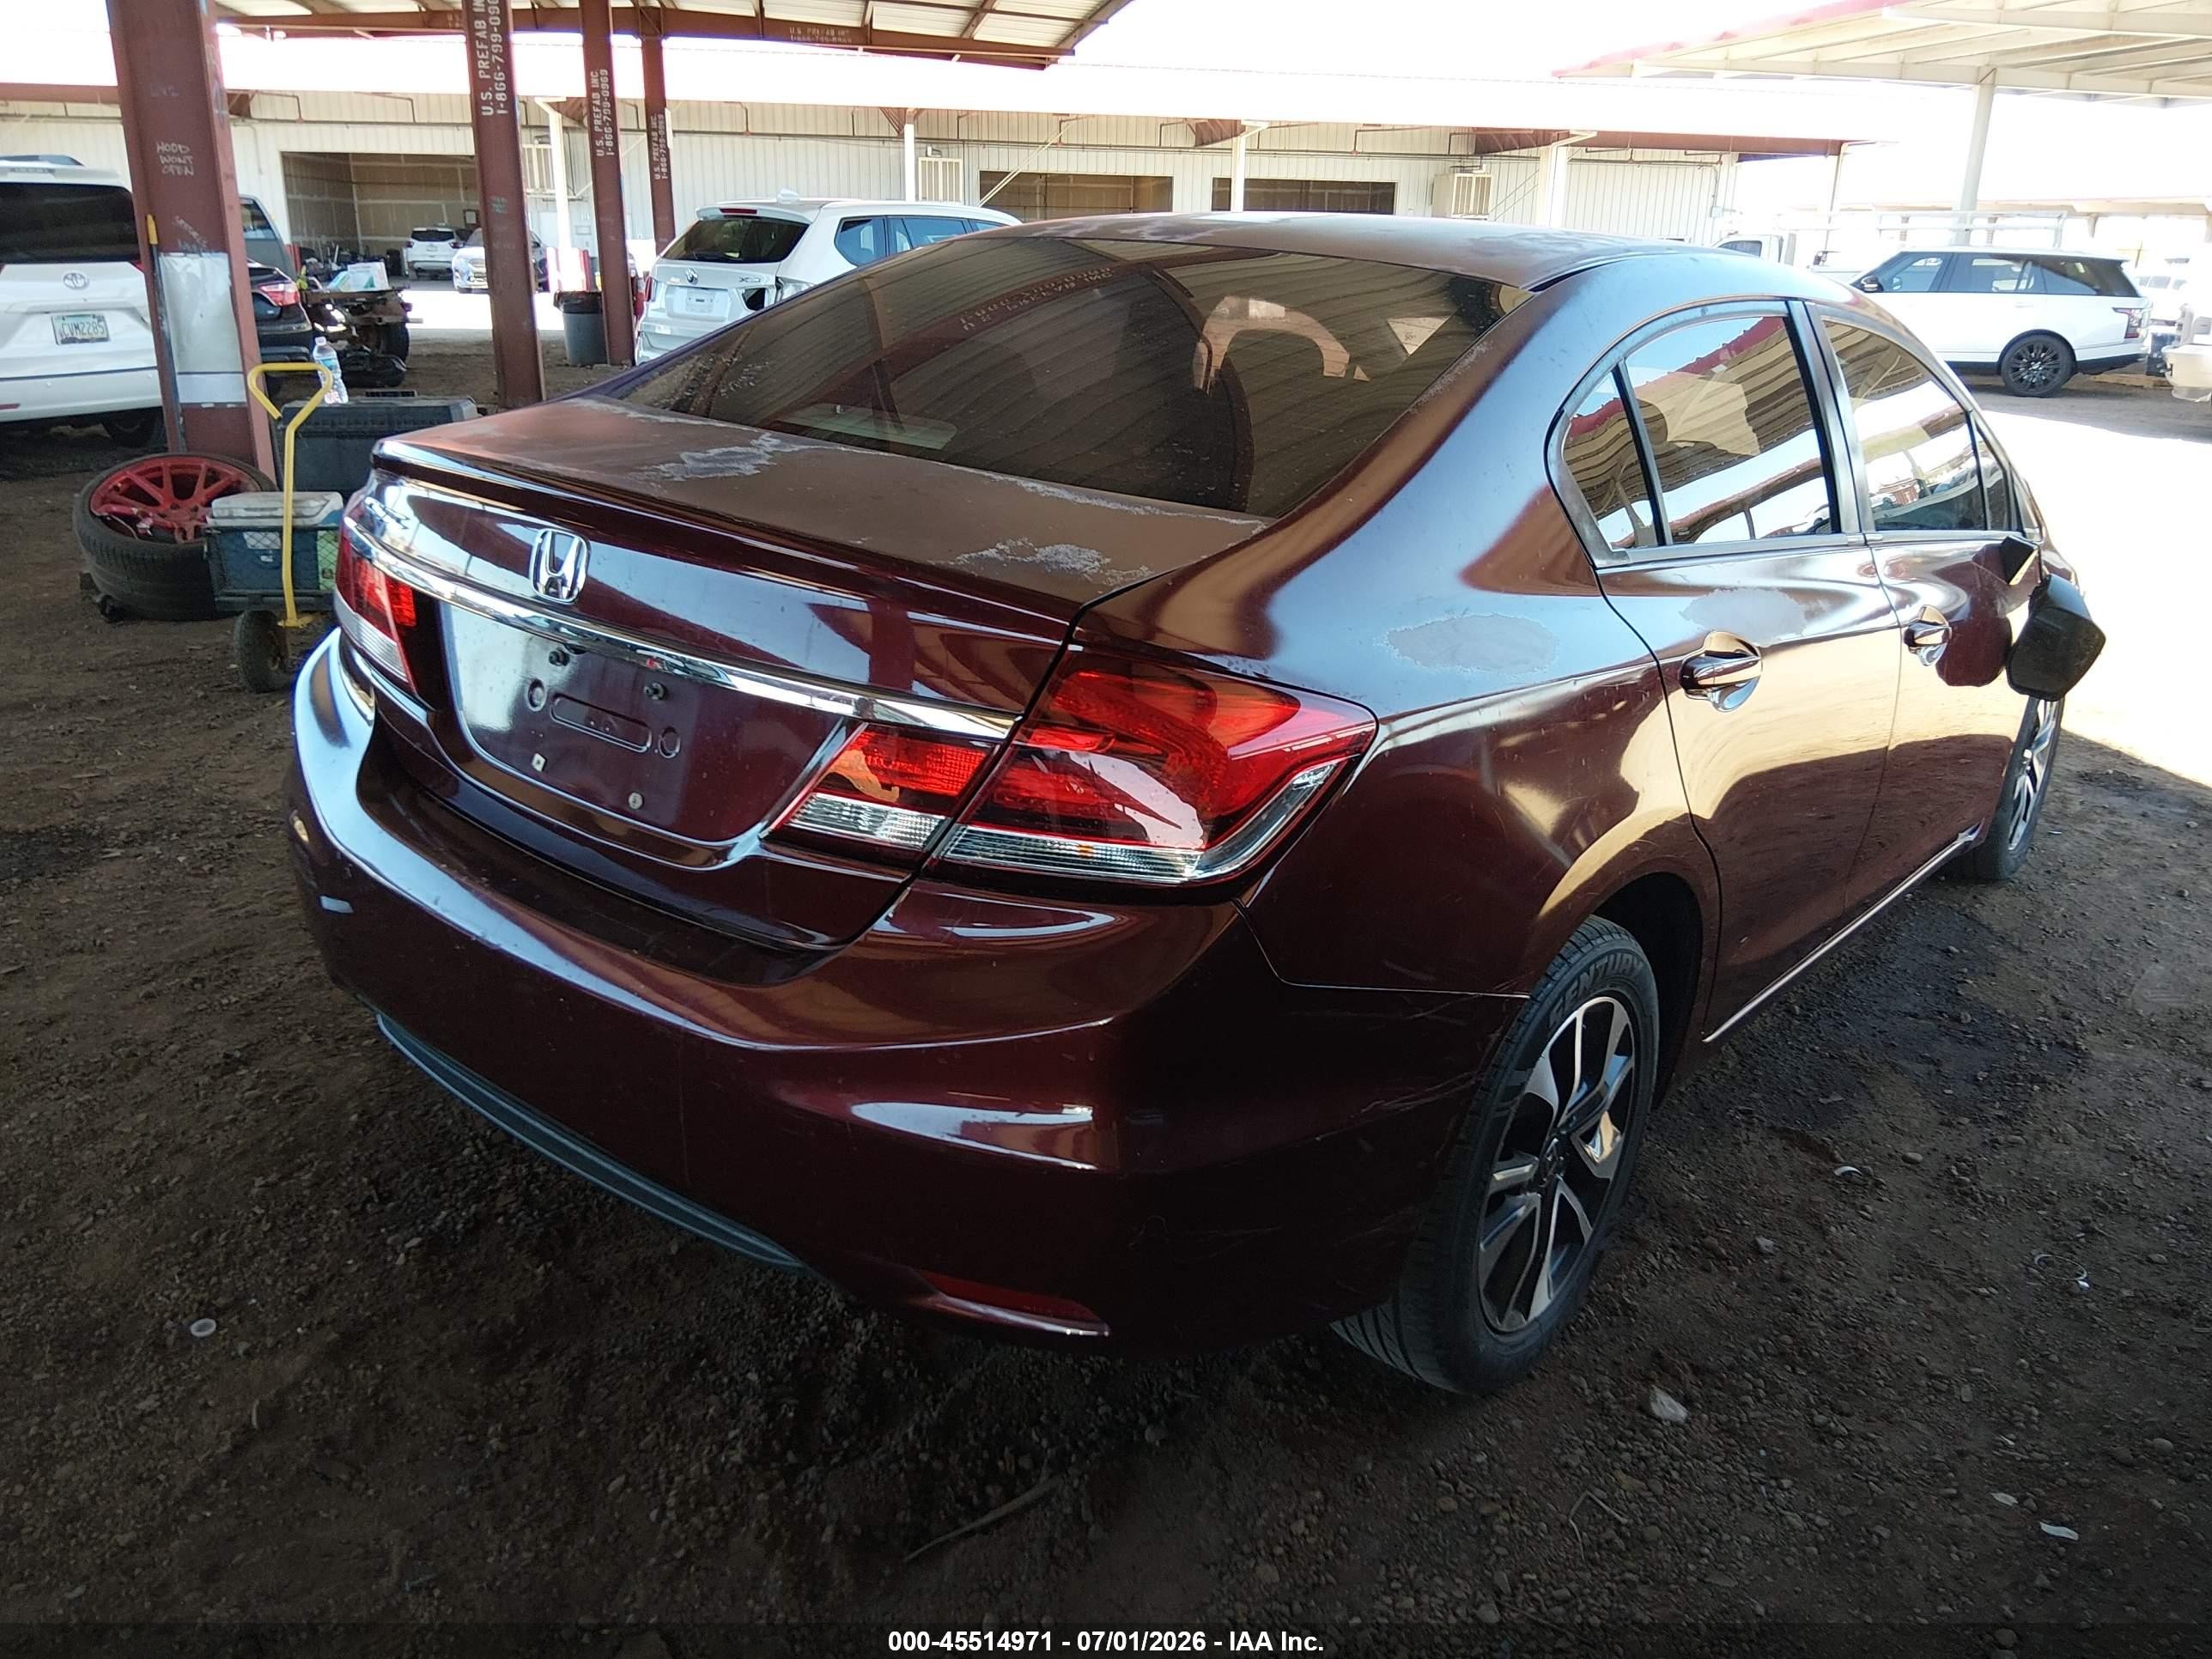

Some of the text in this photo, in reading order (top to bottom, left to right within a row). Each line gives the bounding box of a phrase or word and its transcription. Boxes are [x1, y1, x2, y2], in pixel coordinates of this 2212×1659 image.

[474, 20, 491, 79] PREFAB
[481, 87, 494, 115] U.S.
[592, 92, 604, 132] PREFAB
[599, 69, 615, 155] 1-866-799-0969
[156, 141, 191, 154] HOOD
[159, 155, 193, 165] WONT
[595, 137, 605, 156] U.S.
